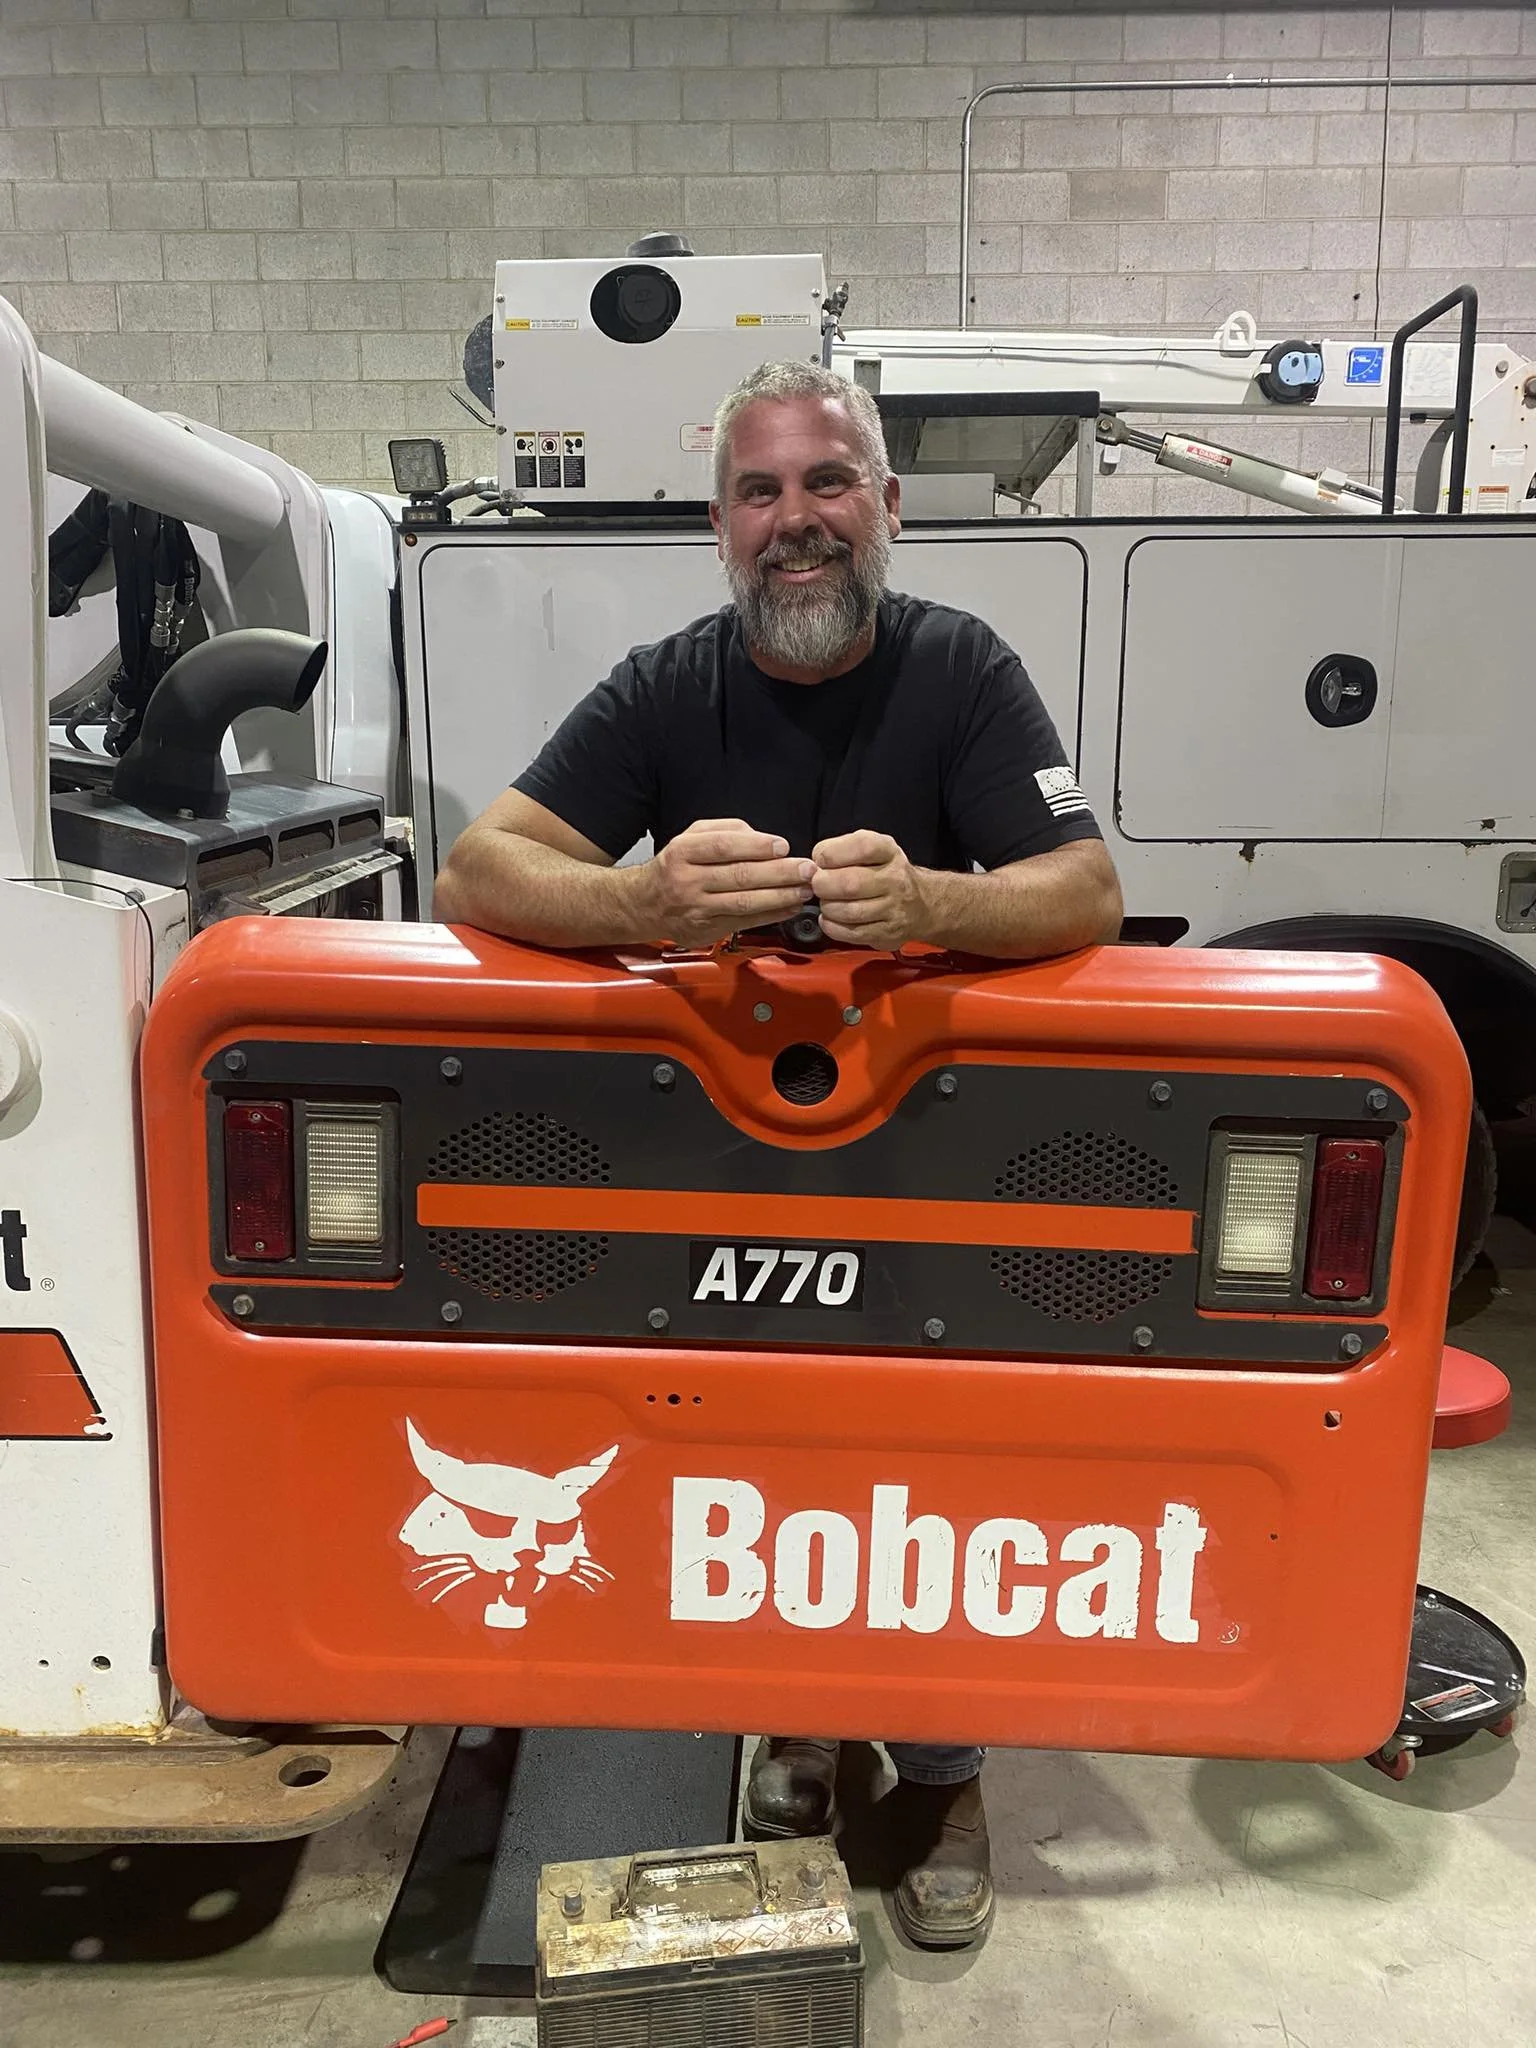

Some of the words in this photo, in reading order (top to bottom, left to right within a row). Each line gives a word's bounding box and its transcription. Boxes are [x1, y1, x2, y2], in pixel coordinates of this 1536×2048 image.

[1199, 449, 1228, 464] DANGER
[693, 1247, 860, 1306] A770
[670, 1476, 1207, 1643] Bobcat
